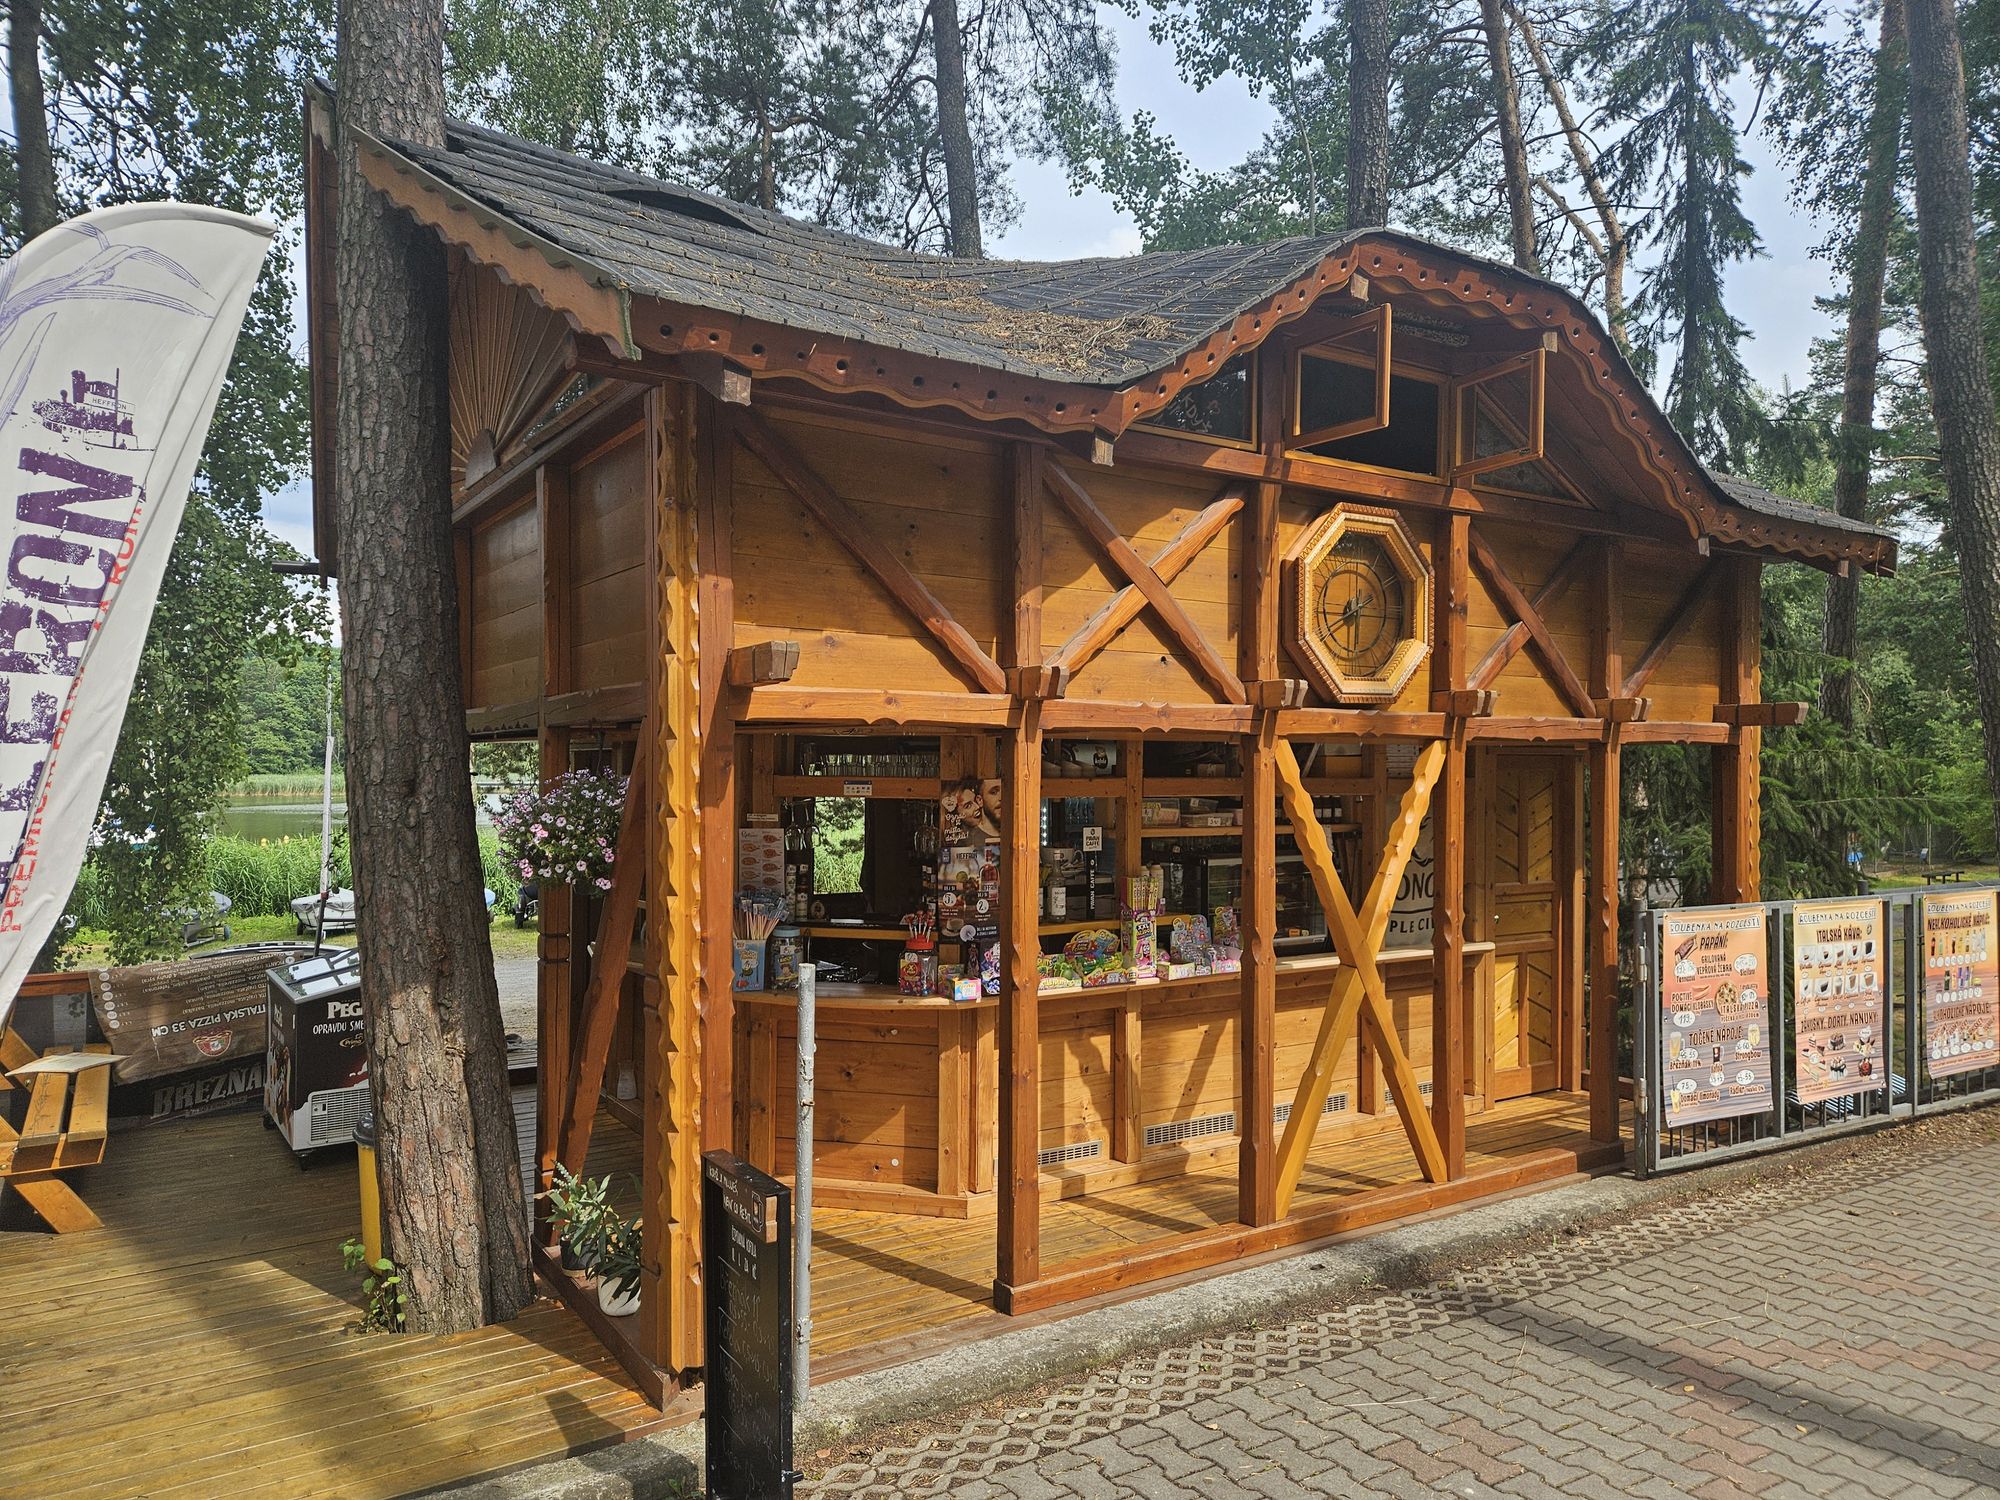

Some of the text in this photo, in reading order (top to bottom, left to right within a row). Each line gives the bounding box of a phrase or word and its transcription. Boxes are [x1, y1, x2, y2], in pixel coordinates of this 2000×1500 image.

[91, 398, 127, 410] HEFFRON
[1700, 932, 1728, 950] PAPÁNÍ:
[1816, 924, 1862, 943] ITALSKÁ KÁVA:
[223, 1003, 266, 1022] ITALSKÁ
[327, 1002, 363, 1019] PEG
[171, 1022, 186, 1033] 33
[188, 1013, 220, 1029] PIZZA
[312, 1020, 365, 1035] OPRAVDU SME
[151, 1025, 168, 1037] CM
[1689, 1025, 1744, 1046] TOČENÉ NÁPOJE:
[1735, 1051, 1762, 1060] Strongbow
